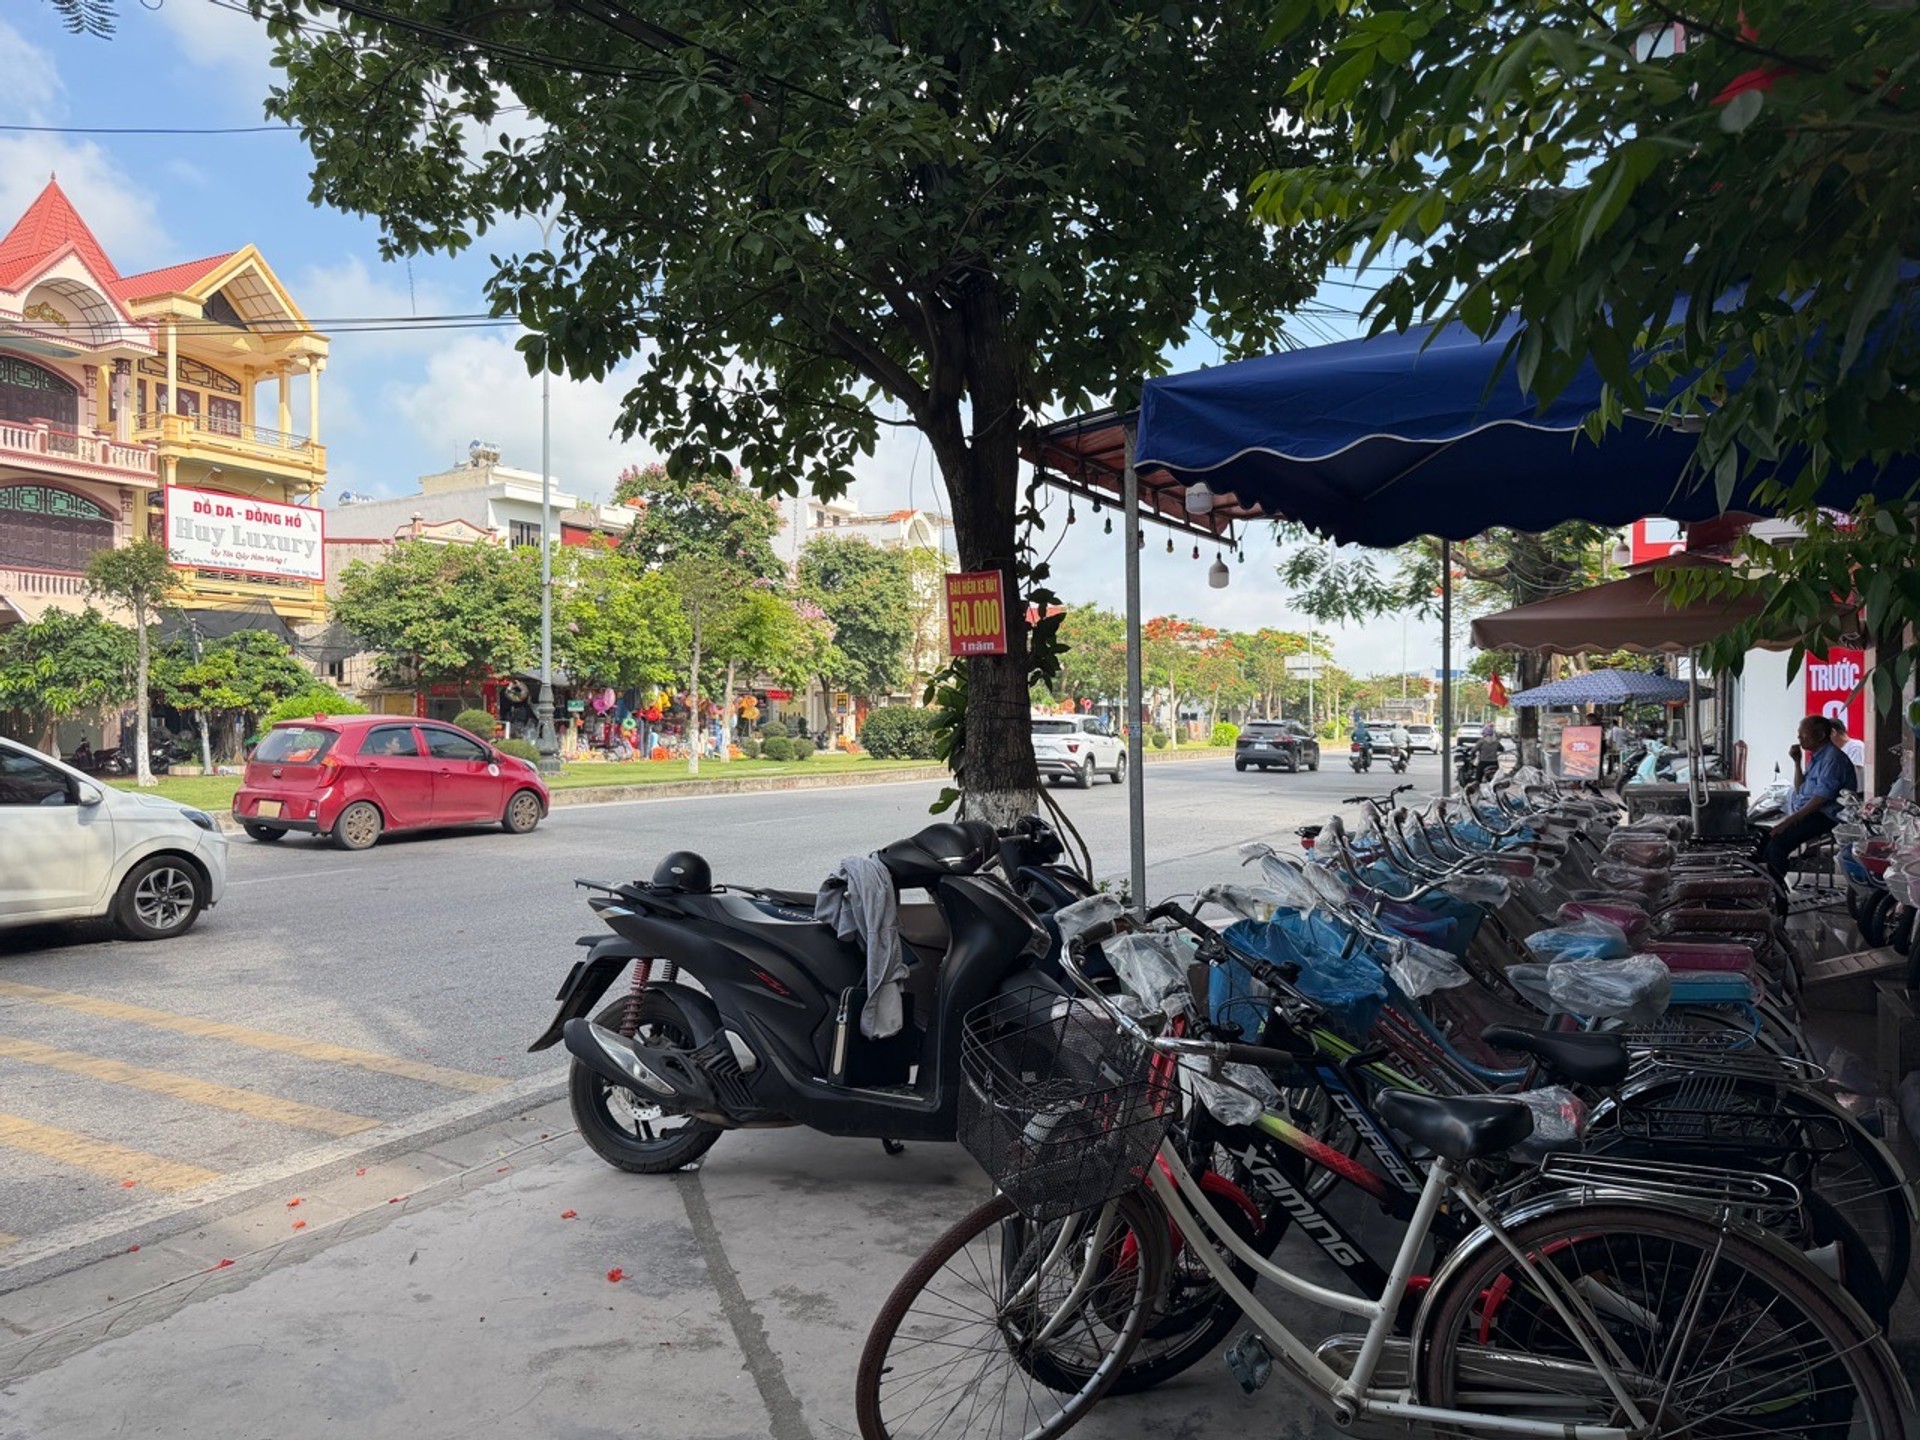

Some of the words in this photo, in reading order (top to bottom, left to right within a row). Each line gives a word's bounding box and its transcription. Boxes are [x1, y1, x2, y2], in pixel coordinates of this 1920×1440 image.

[216, 506, 234, 518] DA
[175, 516, 226, 547] Huy
[232, 525, 317, 558] Luxury
[952, 599, 999, 636] 50.000
[961, 641, 966, 651] 1
[968, 640, 995, 651] năm
[1809, 657, 1860, 691] TRƯỚC
[1331, 1095, 1421, 1194] DRAGO
[1229, 1143, 1365, 1266] XAMING
